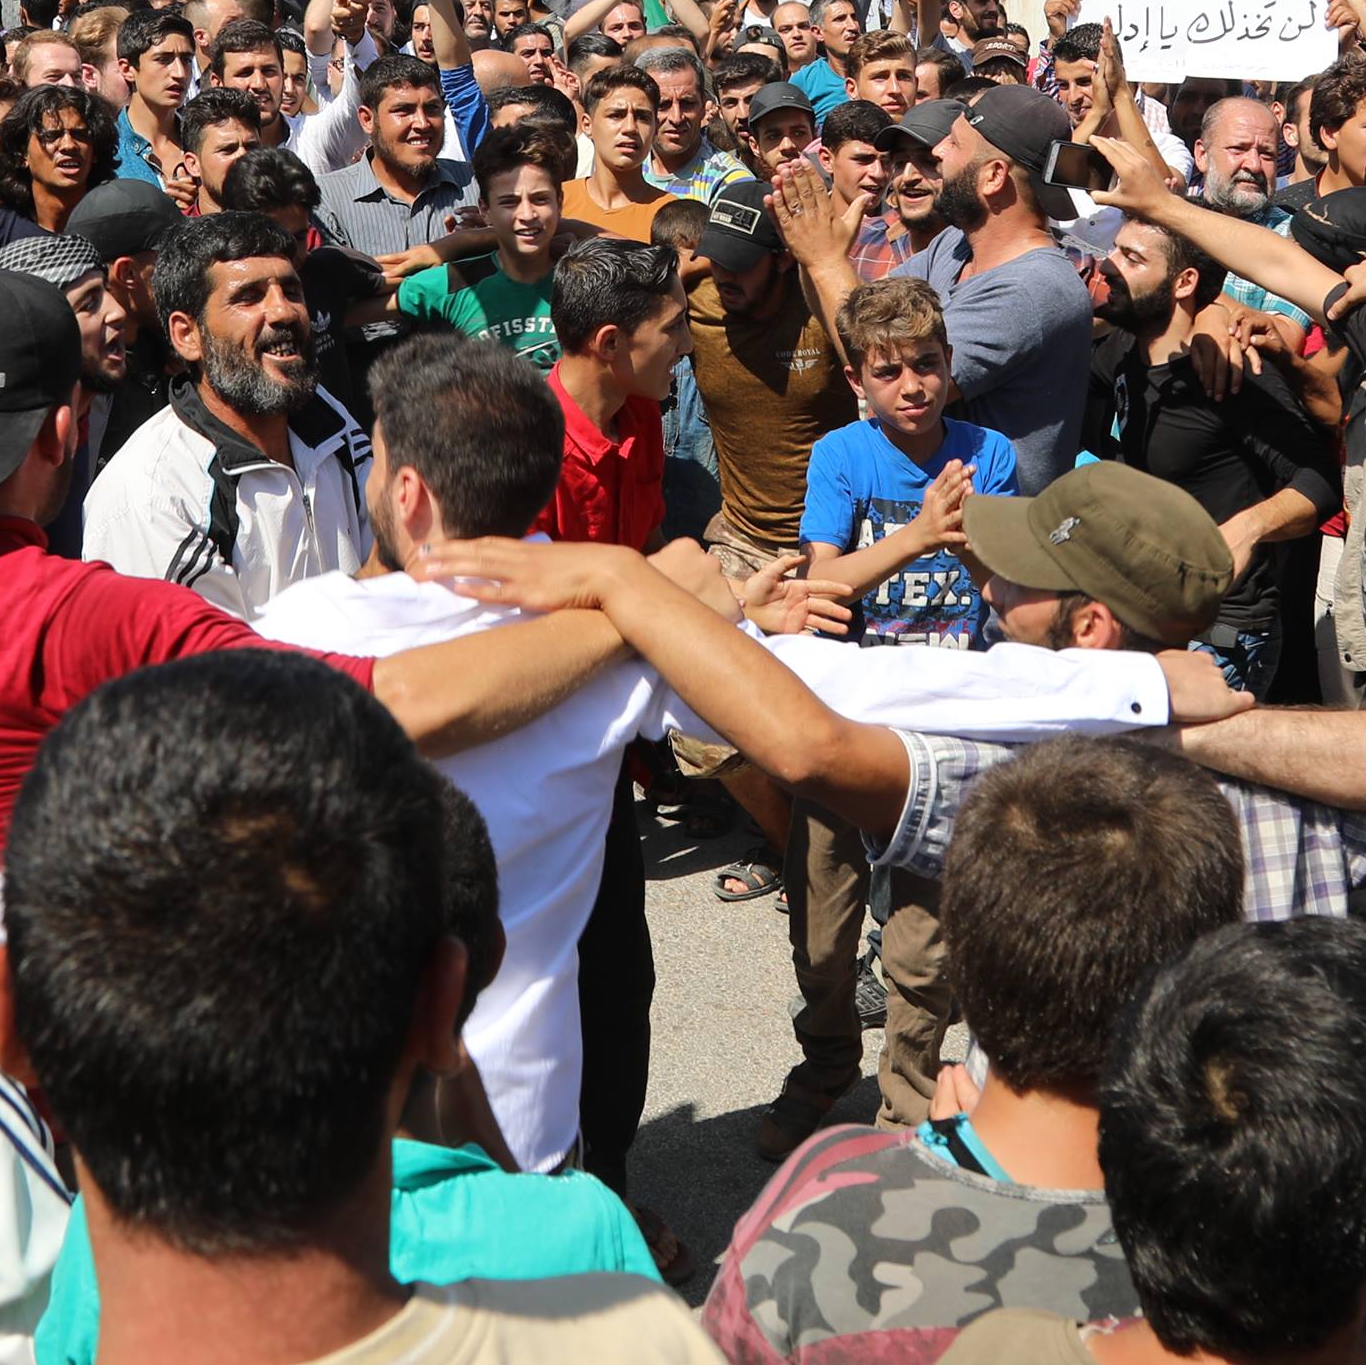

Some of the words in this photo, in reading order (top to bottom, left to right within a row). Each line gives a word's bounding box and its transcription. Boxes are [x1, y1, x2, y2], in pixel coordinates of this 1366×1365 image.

[1113, 3, 1151, 53] إدل
[1159, 5, 1179, 50] يا
[1278, 0, 1317, 42] لن
